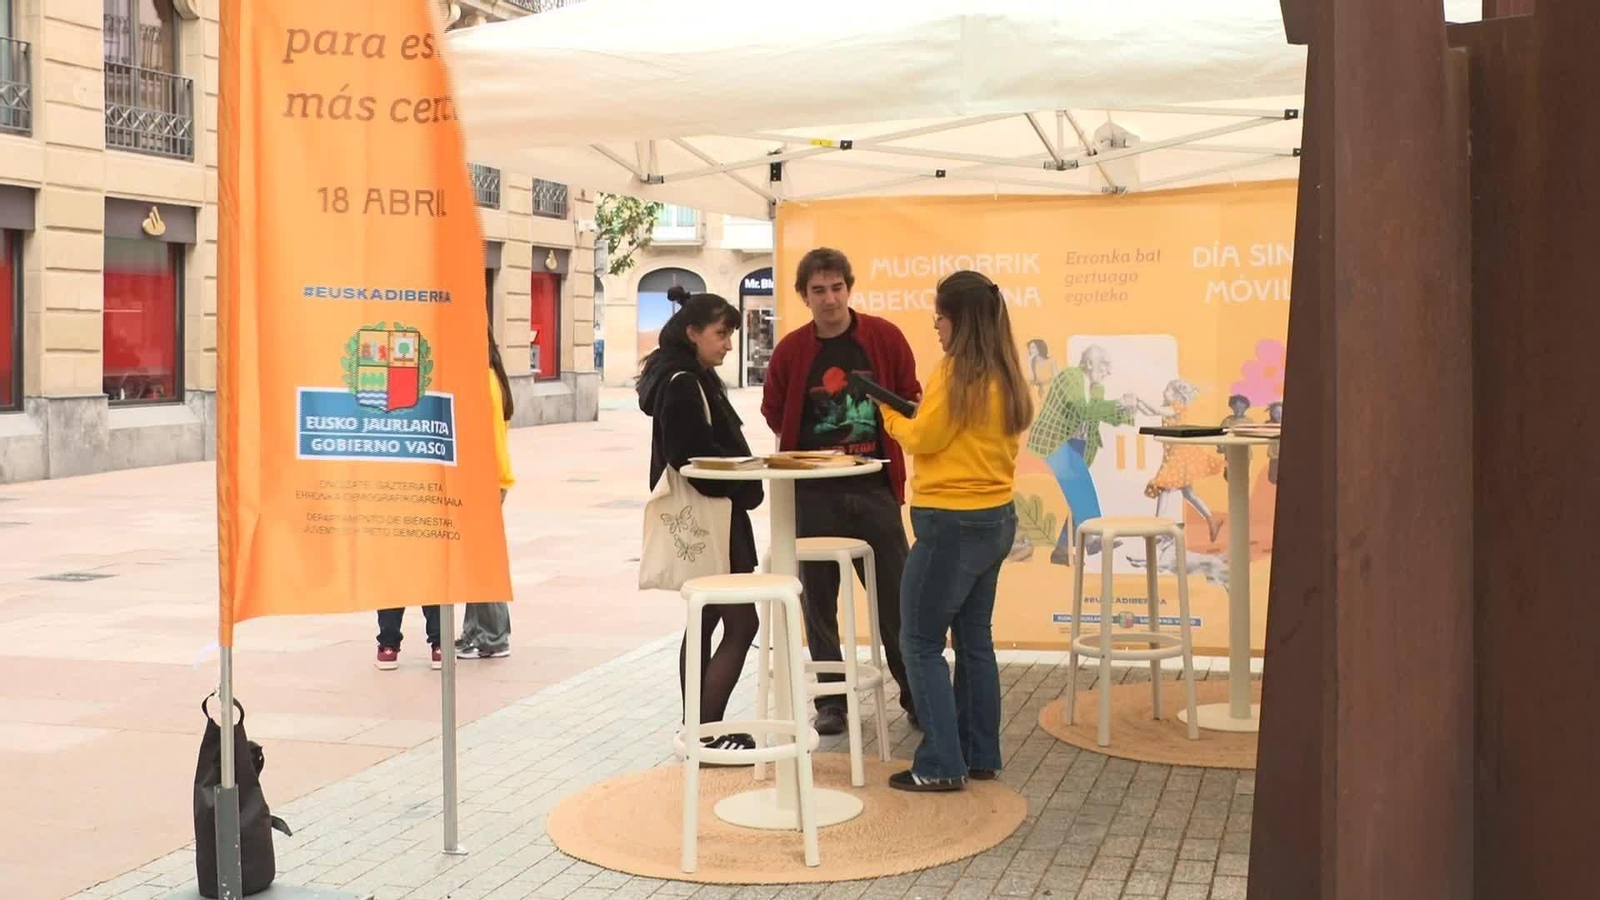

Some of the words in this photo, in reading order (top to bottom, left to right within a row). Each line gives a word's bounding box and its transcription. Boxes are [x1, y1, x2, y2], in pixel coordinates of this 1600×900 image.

[282, 28, 386, 64] para
[400, 32, 440, 60] es
[283, 83, 377, 121] más
[317, 186, 349, 214] 18
[363, 187, 447, 218] ABRIL
[1065, 248, 1131, 265] Erronka
[1135, 247, 1162, 264] bat
[1191, 240, 1241, 269] DÍA
[1250, 242, 1295, 268] SIN
[870, 252, 1041, 280] MUGIKORRIK
[745, 278, 760, 289] Mr.
[1064, 270, 1139, 287] gertuago
[847, 287, 938, 311] ABEKO
[1064, 288, 1130, 306] egoteko
[305, 416, 358, 431] EUSKO
[361, 417, 449, 436] JAURLARITZA
[311, 438, 401, 453] GOBIERNO
[405, 440, 446, 456] VASCO
[427, 482, 444, 492] ETA
